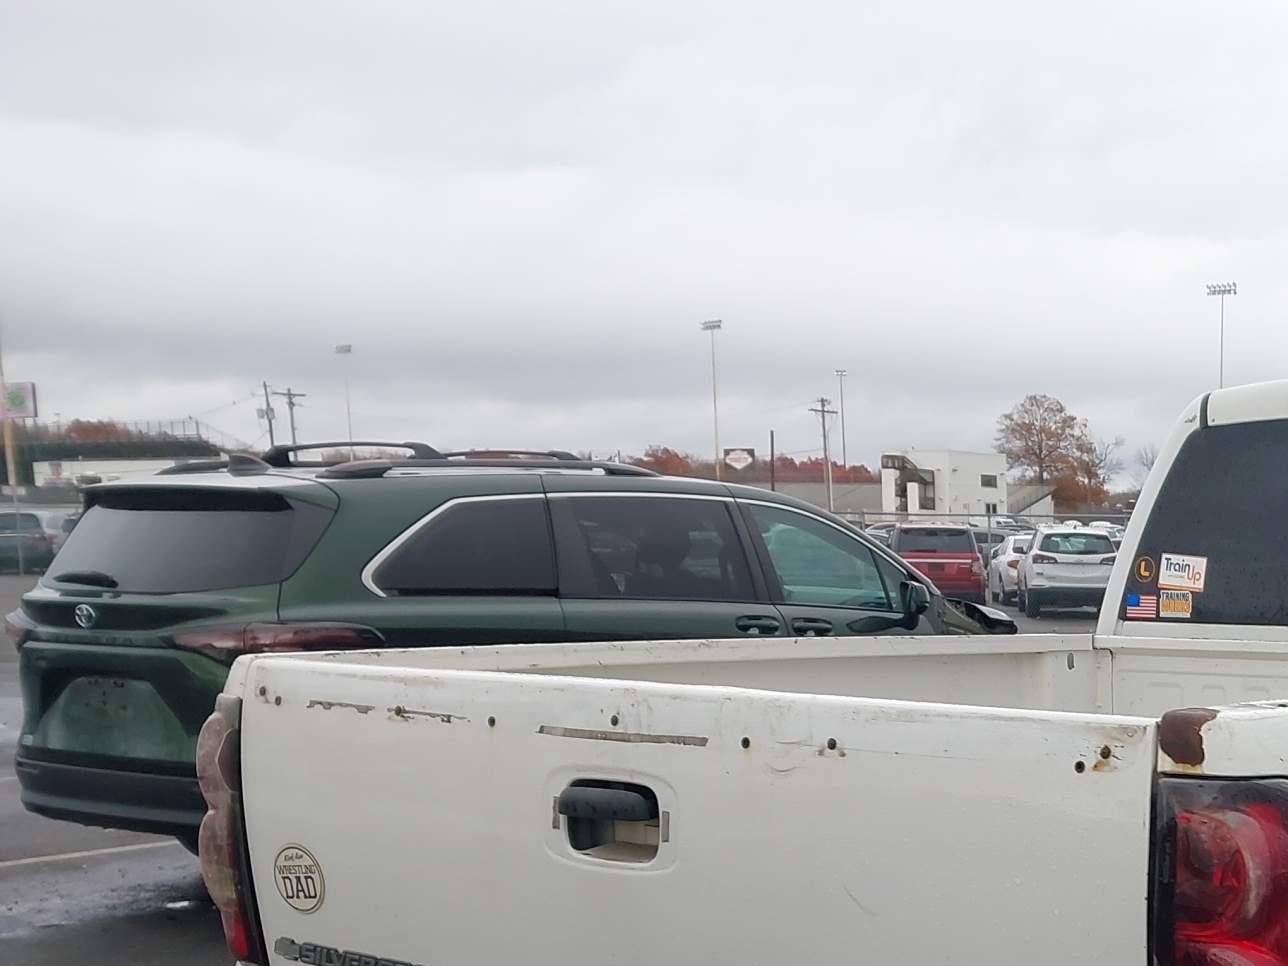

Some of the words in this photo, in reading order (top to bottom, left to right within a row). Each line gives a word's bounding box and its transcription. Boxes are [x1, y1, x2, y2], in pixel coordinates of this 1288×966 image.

[1165, 557, 1191, 574] Train
[1162, 591, 1190, 601] TRAINING
[281, 875, 317, 899] DAD
